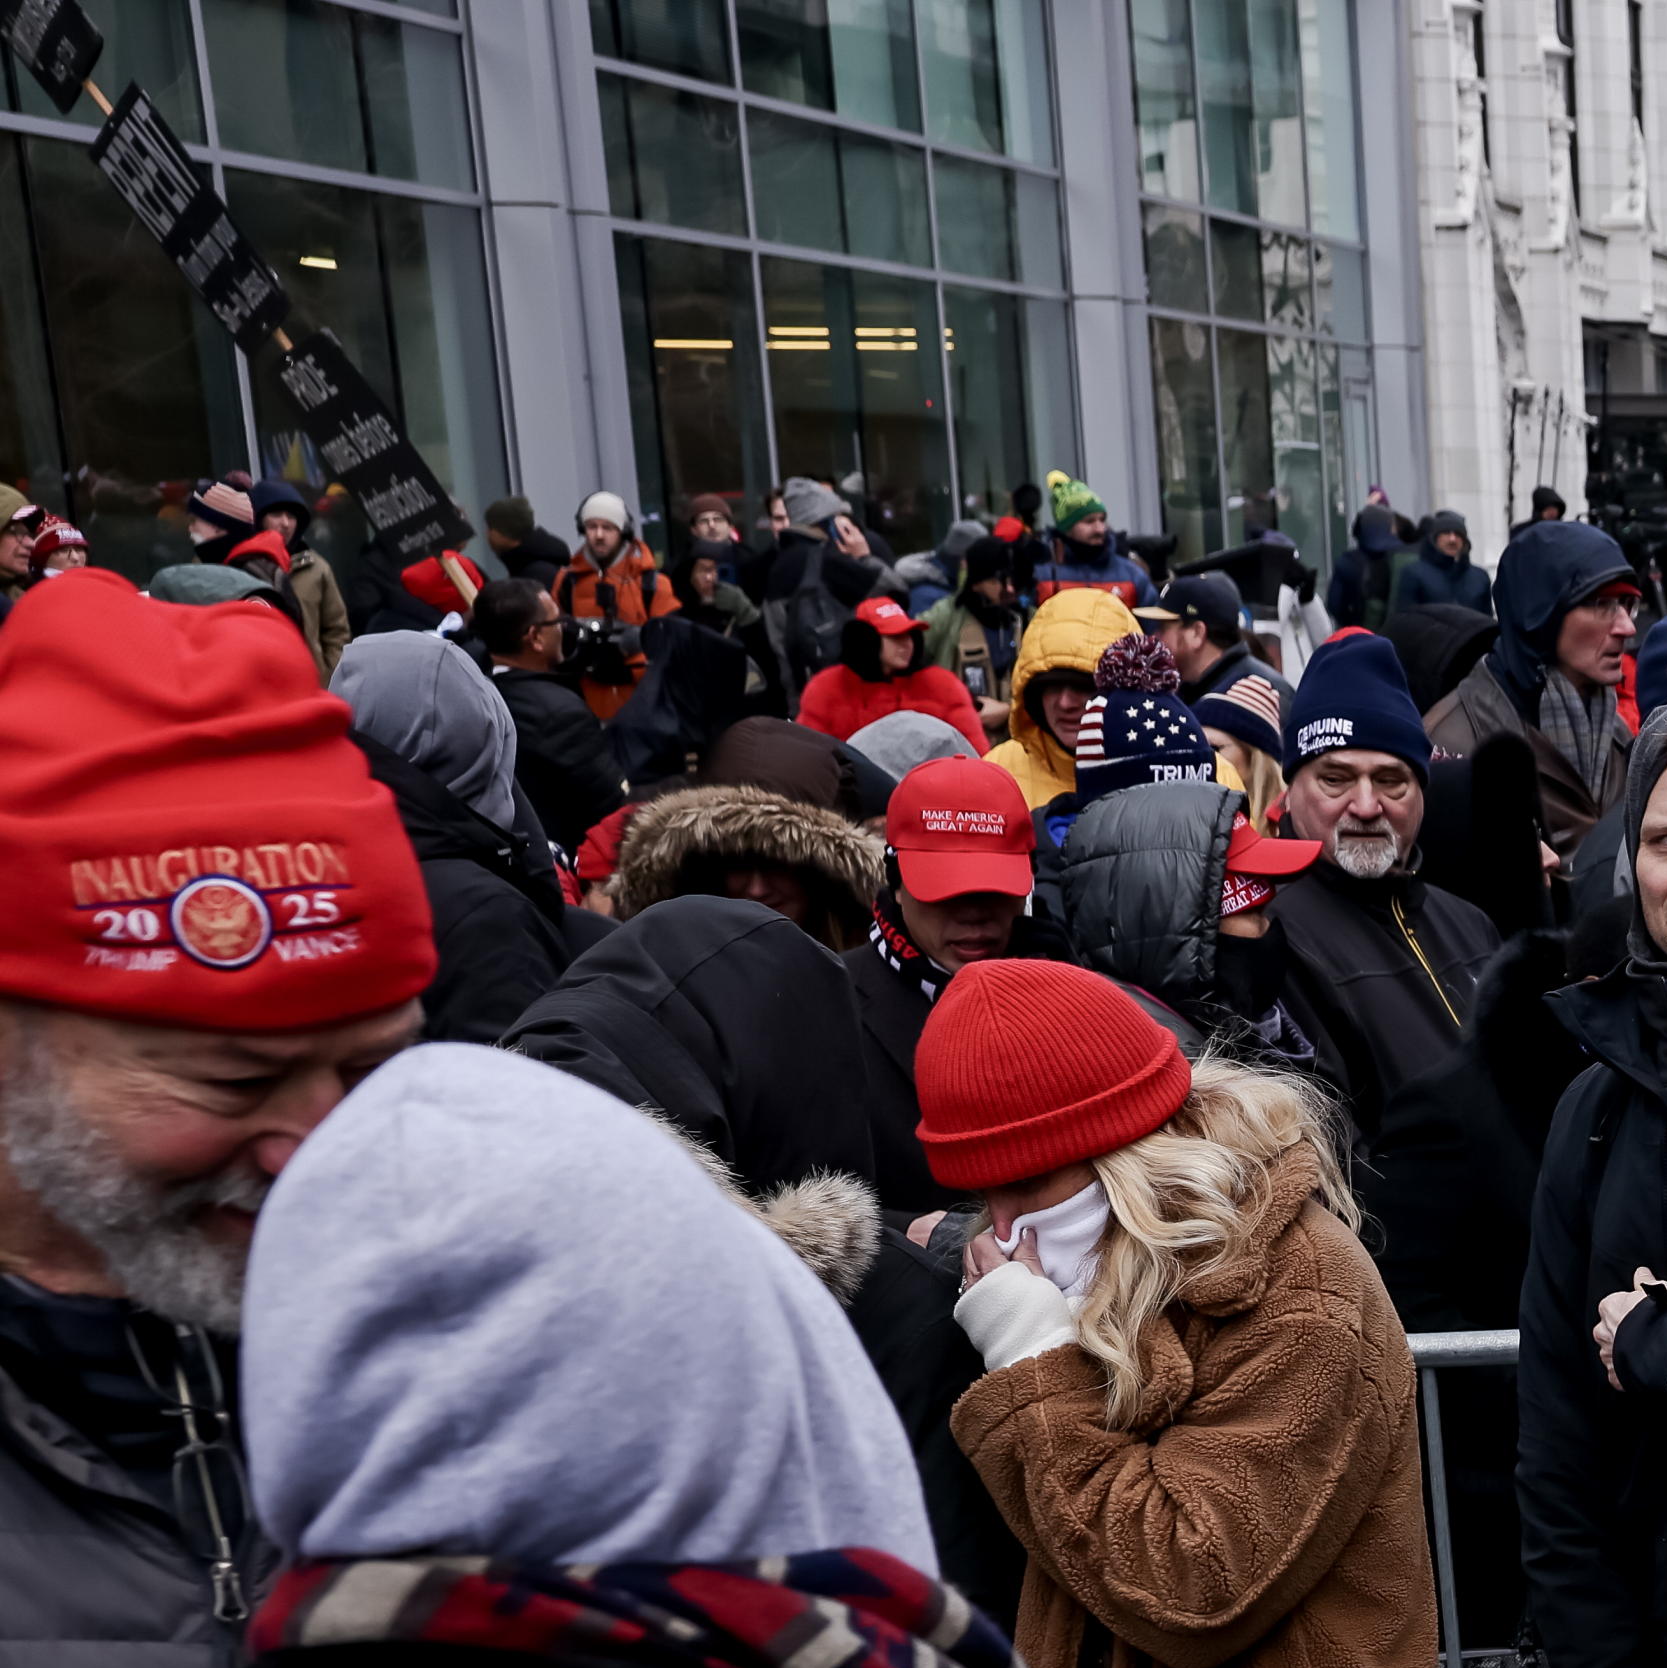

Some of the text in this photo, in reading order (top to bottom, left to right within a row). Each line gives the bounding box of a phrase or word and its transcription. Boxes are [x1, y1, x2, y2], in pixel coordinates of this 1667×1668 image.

[100, 97, 201, 243] REPENT
[280, 353, 340, 412] PRIDE
[340, 410, 400, 461] before
[1298, 718, 1353, 748] GENUINE
[1300, 734, 1347, 756] Builders
[1149, 761, 1212, 783] TRUMP
[922, 809, 1005, 825] MAKE AMERICA
[926, 820, 1004, 835] GREAT AGAIN
[70, 842, 349, 906] INAUGURATION
[93, 907, 160, 941] 20
[281, 891, 341, 927] 25
